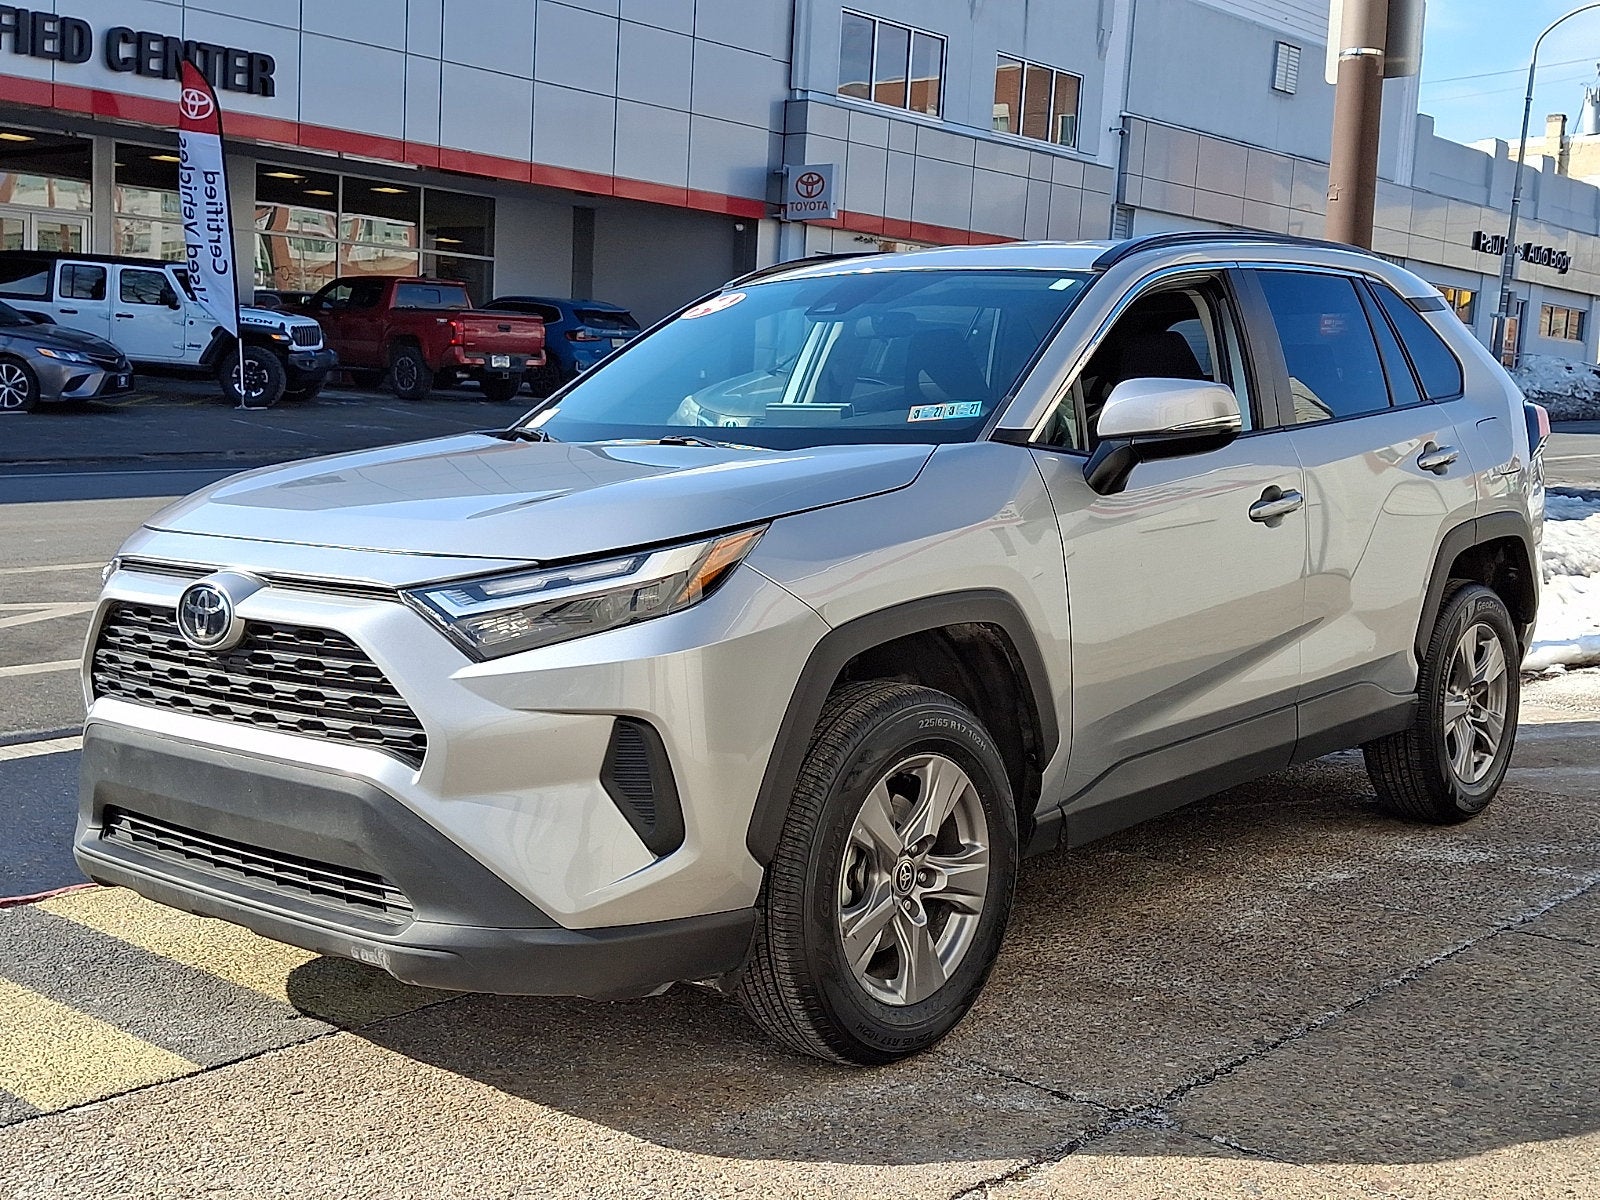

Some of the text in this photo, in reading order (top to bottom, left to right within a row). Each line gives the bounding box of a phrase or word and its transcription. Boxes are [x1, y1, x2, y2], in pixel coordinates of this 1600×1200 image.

[106, 26, 275, 97] CENTER
[789, 201, 828, 212] TOYOTA
[1474, 231, 1503, 255] Paul
[1526, 243, 1549, 266] Auto
[914, 407, 943, 420] 3 27
[970, 403, 979, 415] 27
[919, 717, 987, 751] 225/65 R17 102H
